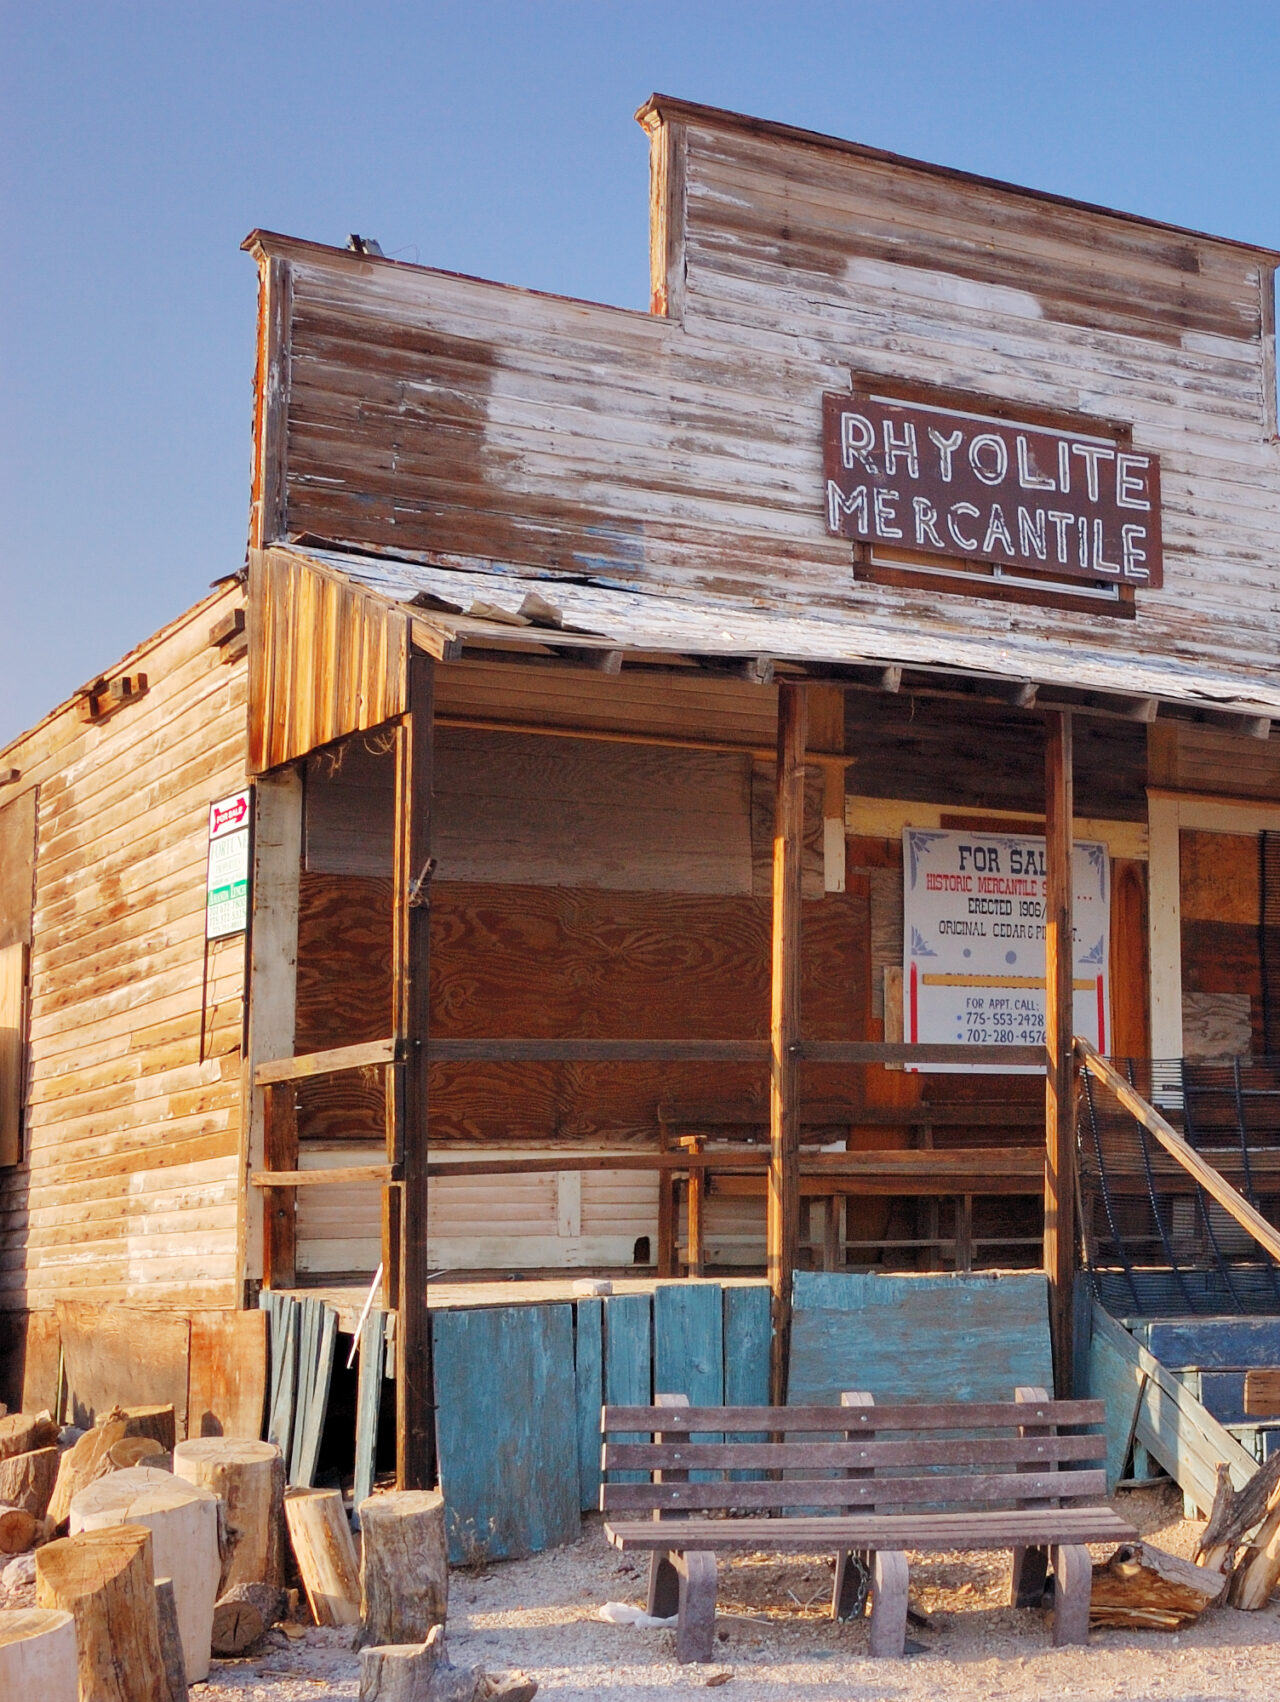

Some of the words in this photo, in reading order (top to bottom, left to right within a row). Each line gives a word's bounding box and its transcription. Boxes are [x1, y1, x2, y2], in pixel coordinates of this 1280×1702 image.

[841, 411, 1150, 511] RHYOLITE
[826, 479, 1149, 578] MERCANTILE
[216, 814, 227, 824] FOR
[227, 807, 243, 820] SALE
[958, 845, 1000, 873] FOR
[1010, 849, 1047, 876] SAL
[926, 873, 973, 892] HISTORIC
[978, 876, 1037, 897] MERCANTILE
[968, 898, 1013, 916] ERECTED
[938, 920, 987, 937] ORIGINAL
[966, 997, 984, 1009] FOR
